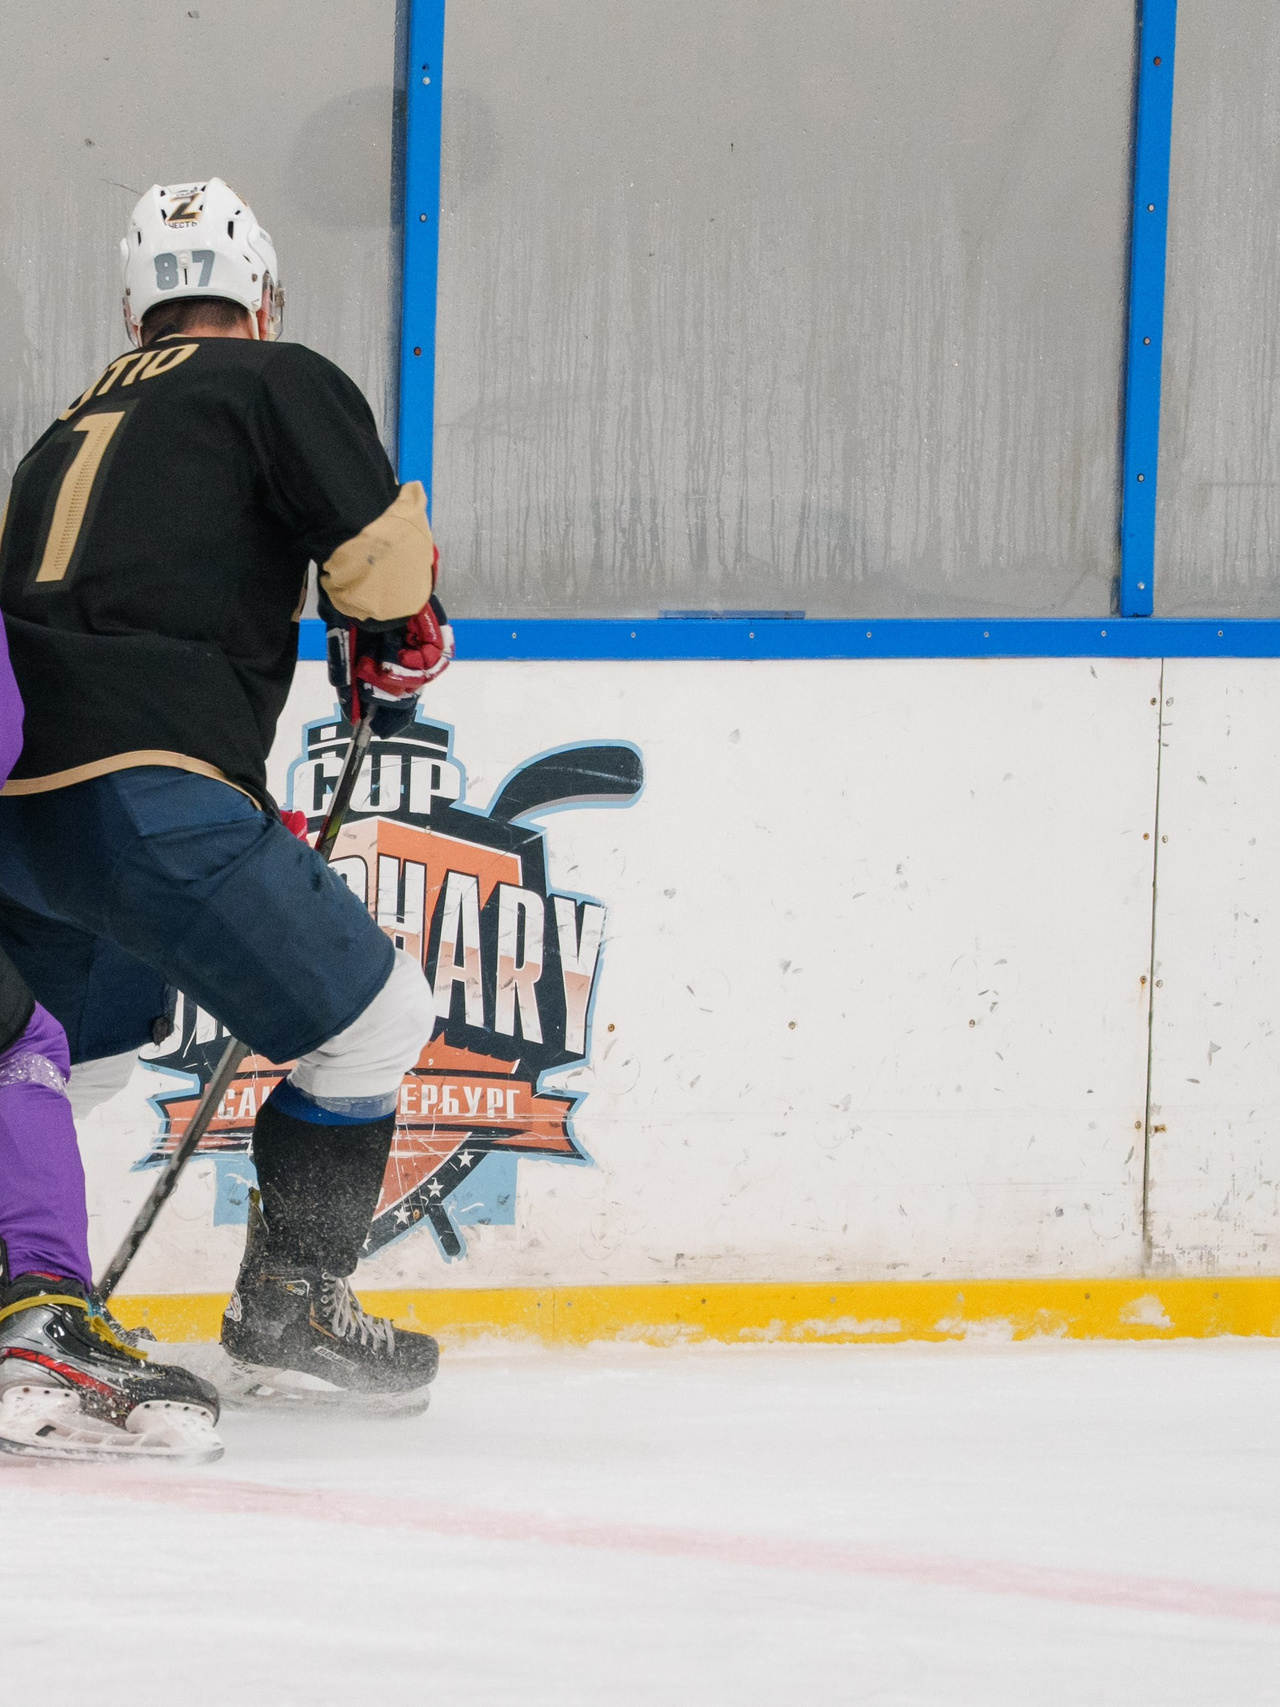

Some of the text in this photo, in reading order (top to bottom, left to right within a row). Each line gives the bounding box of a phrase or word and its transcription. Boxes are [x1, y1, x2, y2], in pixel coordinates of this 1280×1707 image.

[153, 249, 215, 291] 87
[34, 410, 126, 582] 1
[292, 754, 461, 819] CUP
[326, 855, 607, 1055] HARY
[400, 1083, 521, 1119] ЕРБУРГ
